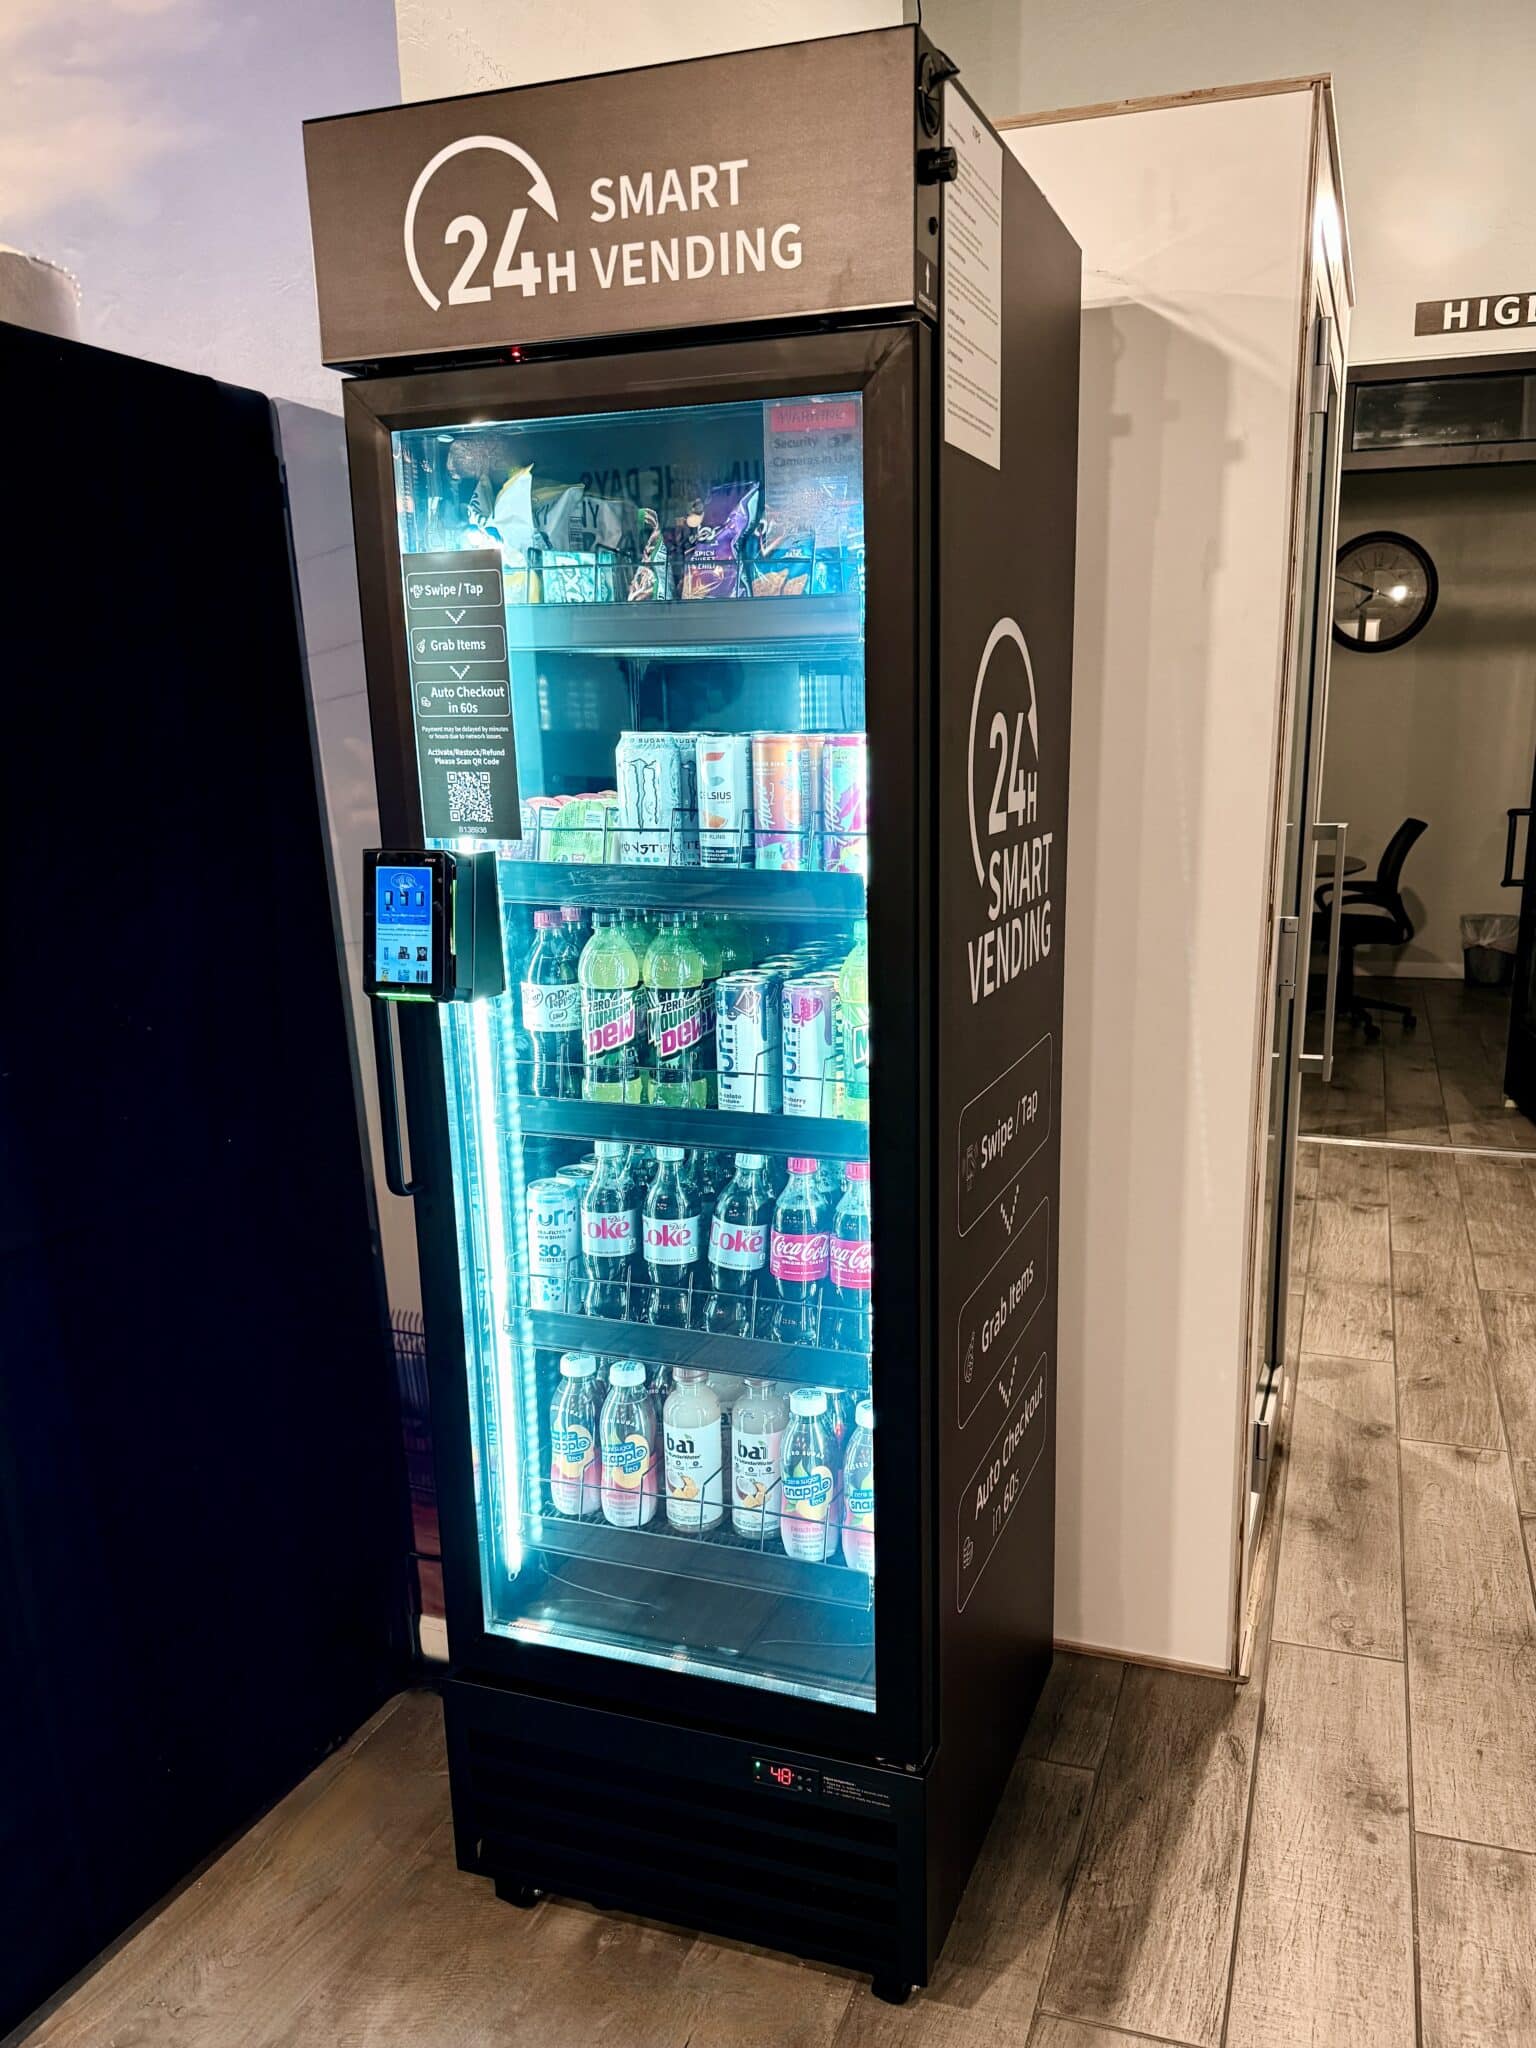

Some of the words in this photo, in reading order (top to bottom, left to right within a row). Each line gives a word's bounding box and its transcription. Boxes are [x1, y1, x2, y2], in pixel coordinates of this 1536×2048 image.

[590, 158, 749, 224] SMART
[444, 207, 577, 307] 24H
[590, 223, 803, 290] VENDING
[774, 436, 818, 449] Security
[424, 583, 457, 598] Swipe
[464, 583, 484, 597] Tap
[430, 639, 455, 651] Grab
[457, 639, 486, 650] Items
[431, 687, 455, 698] Auto
[456, 686, 505, 698] Checkout
[448, 702, 459, 714] in
[460, 702, 478, 714] 60s
[427, 748, 506, 757] Activate/Restock/Refund
[472, 758, 482, 766] QR
[988, 711, 1038, 836] 24H
[988, 832, 1053, 921] SMART
[967, 900, 1052, 1005] VENDING
[980, 1115, 1013, 1169] Swipe
[1020, 1089, 1038, 1127] Tap
[587, 1217, 630, 1240] oke
[710, 1221, 764, 1253] Coke
[981, 1295, 1007, 1353] Grab
[1009, 1259, 1034, 1314] Items
[666, 1432, 695, 1454] bai
[737, 1439, 767, 1460] bai
[975, 1458, 1001, 1521] Auto
[1002, 1375, 1044, 1468] Checkout
[784, 1478, 831, 1500] snapple
[992, 1503, 1001, 1537] in
[1003, 1467, 1020, 1514] 60s
[769, 1766, 792, 1787] 48
